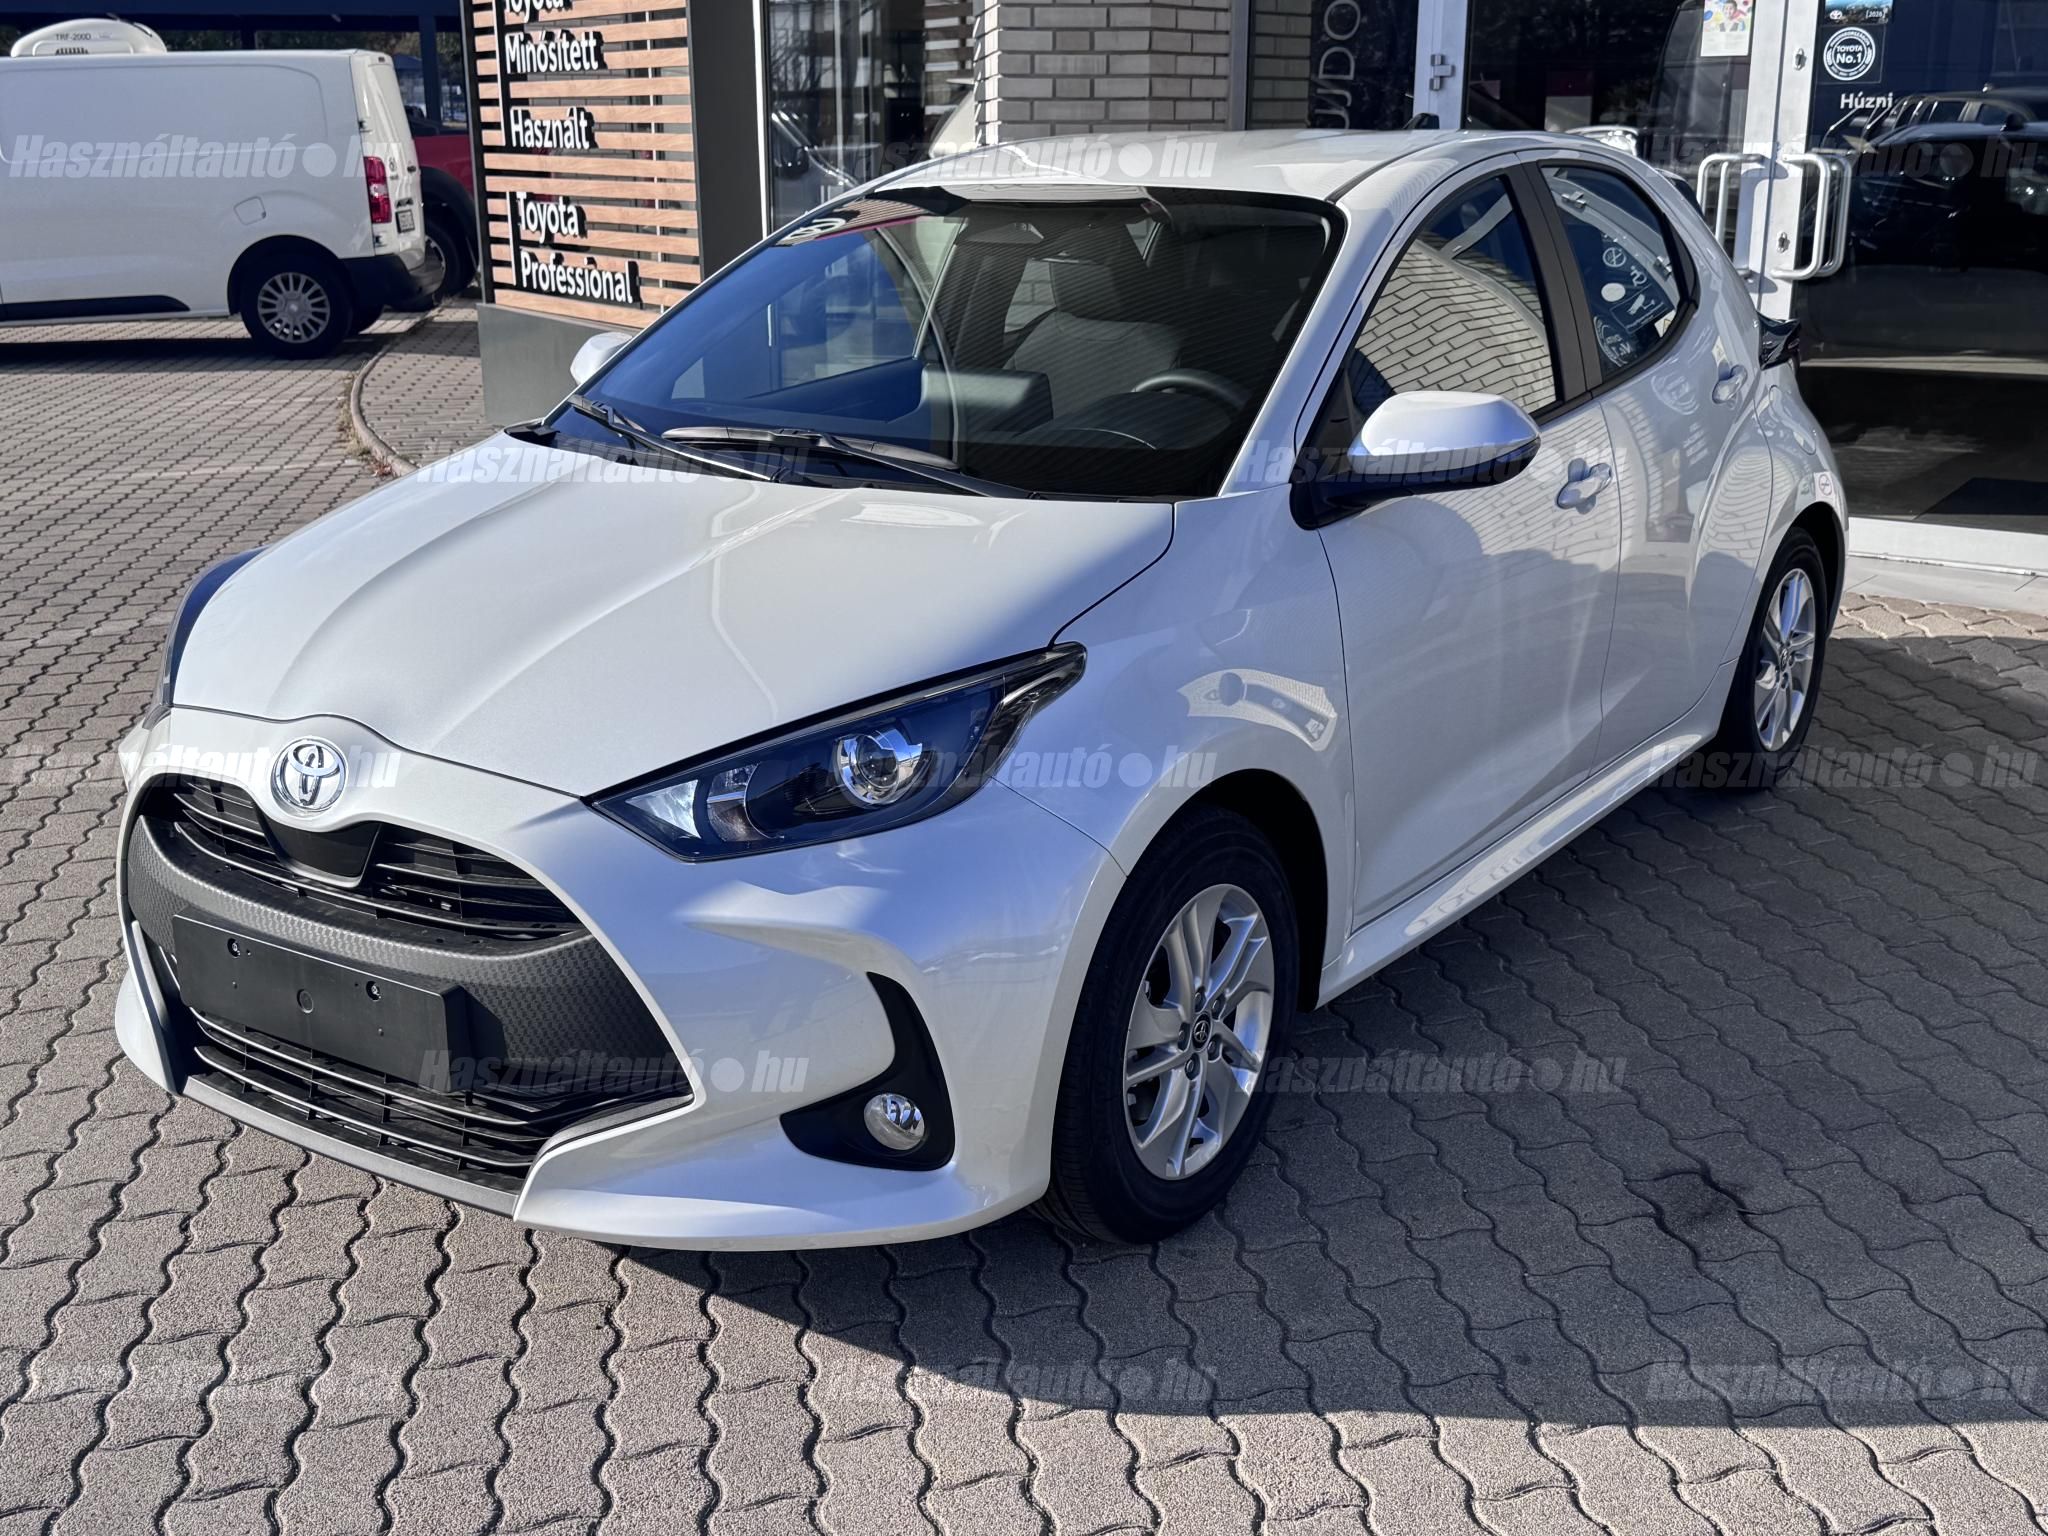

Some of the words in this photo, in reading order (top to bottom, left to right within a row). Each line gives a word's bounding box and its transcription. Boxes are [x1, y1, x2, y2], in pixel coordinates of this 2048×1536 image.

[505, 28, 598, 73] Minősített
[1836, 44, 1863, 53] TOYOTA
[1836, 53, 1862, 64] No.1
[510, 106, 590, 149] Használt
[516, 191, 579, 243] Toyota
[520, 251, 633, 303] Professional
